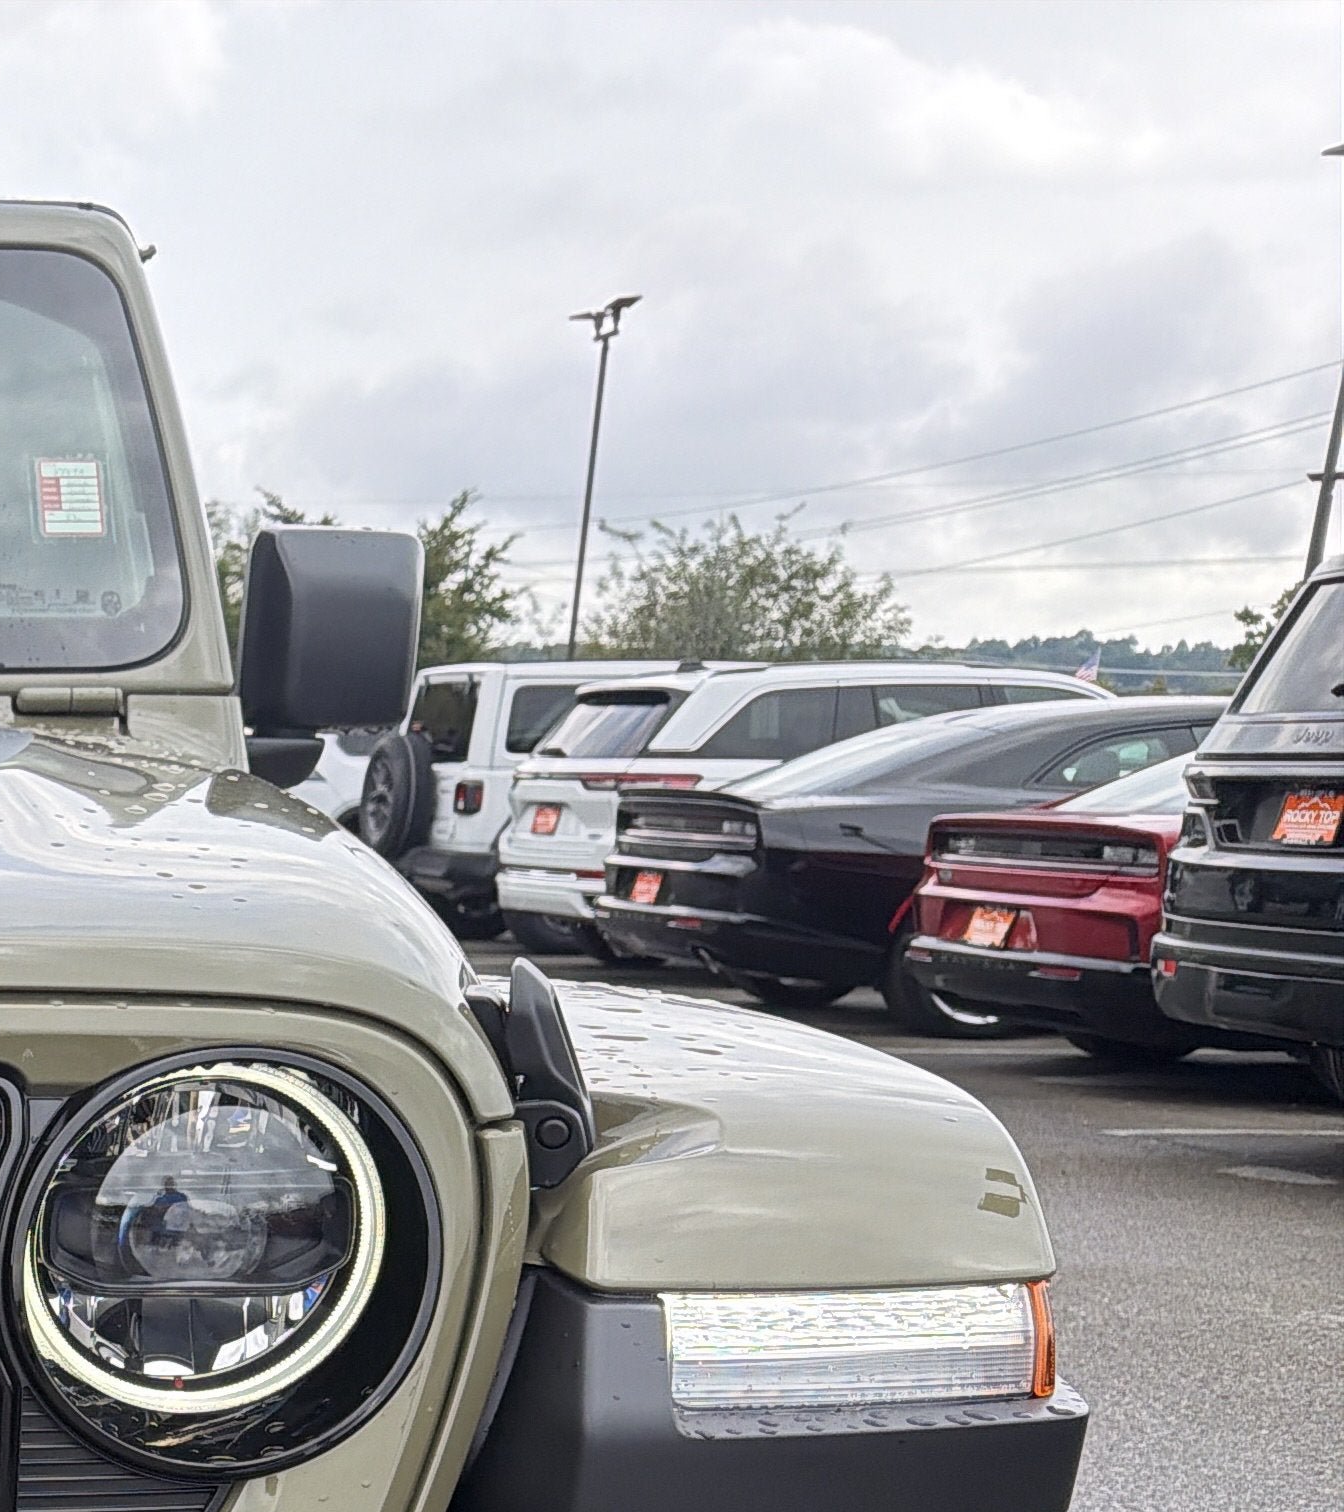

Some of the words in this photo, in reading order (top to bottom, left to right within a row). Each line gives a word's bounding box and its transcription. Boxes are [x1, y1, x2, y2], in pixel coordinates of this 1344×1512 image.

[1293, 726, 1334, 746] Jeep
[1284, 809, 1318, 824] ROCKY
[1318, 809, 1340, 824] TOP
